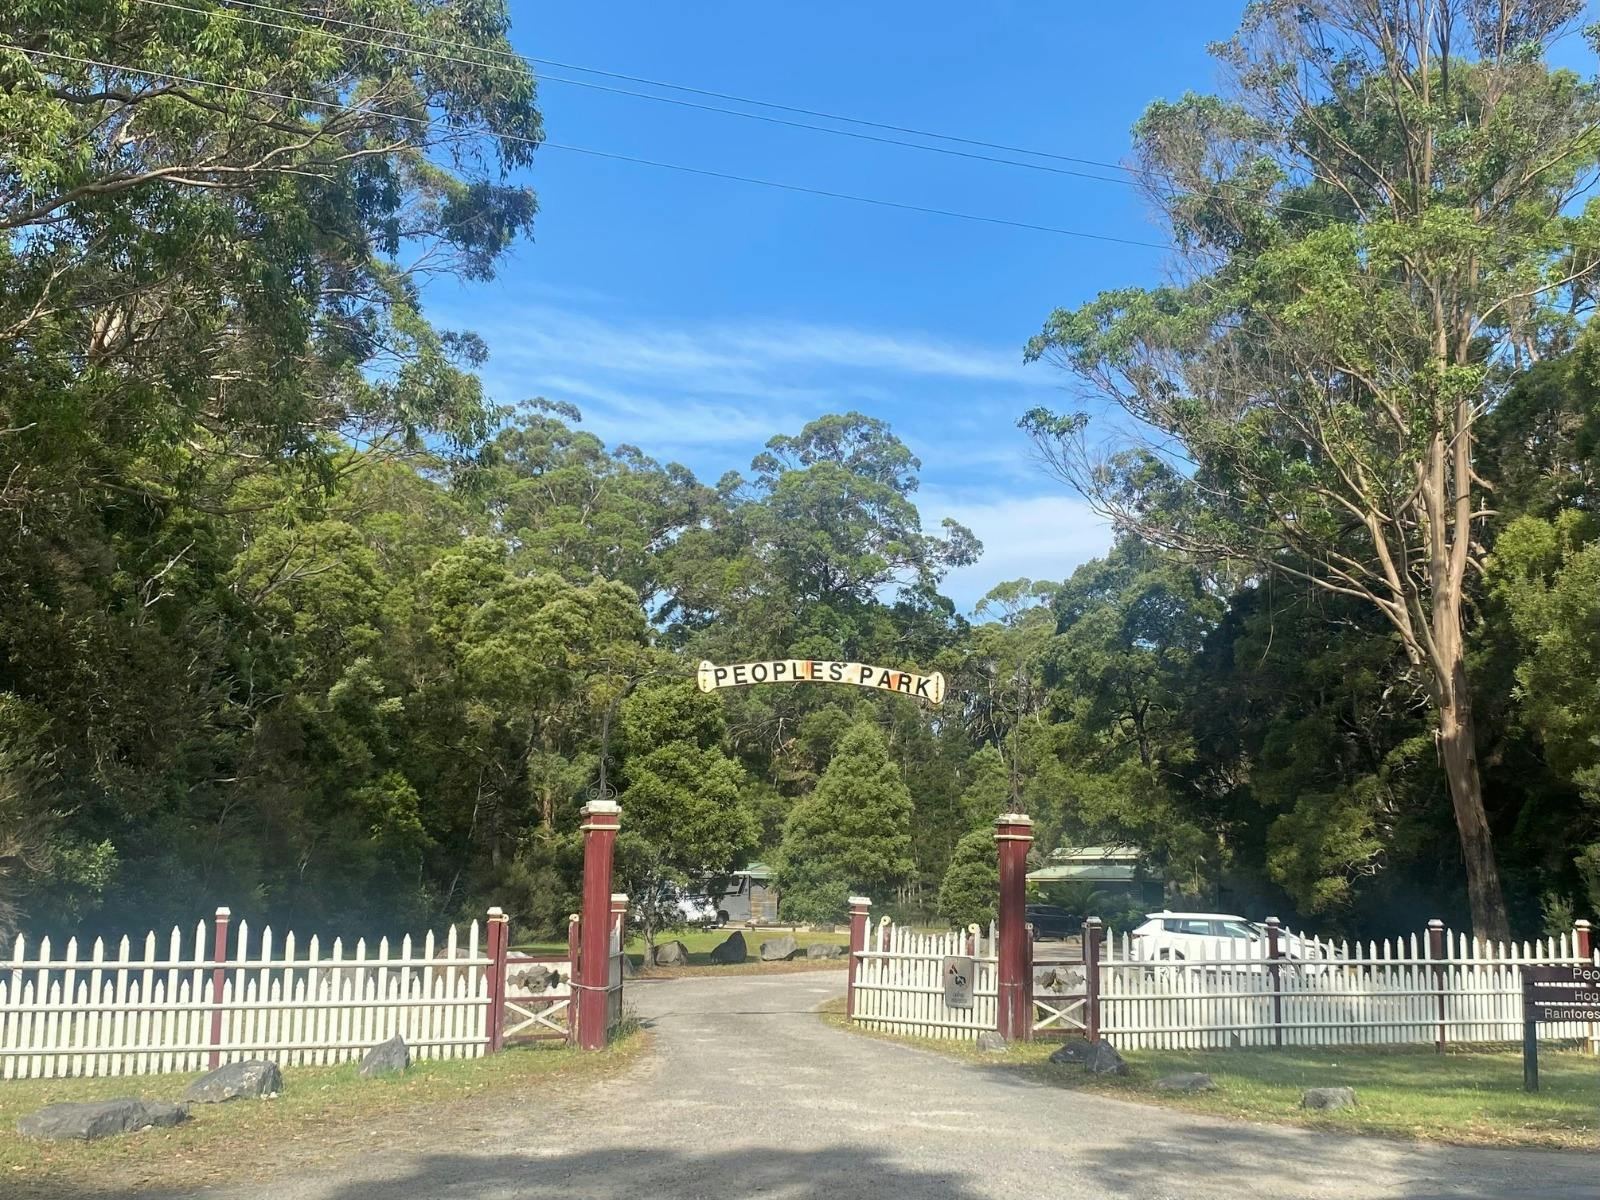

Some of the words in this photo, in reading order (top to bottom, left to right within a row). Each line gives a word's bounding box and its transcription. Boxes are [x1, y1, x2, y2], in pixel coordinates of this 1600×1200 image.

[860, 666, 931, 697] PARK
[1573, 968, 1600, 980] Peo
[1575, 991, 1599, 1002] Hog
[1545, 1008, 1600, 1019] Rainfores
